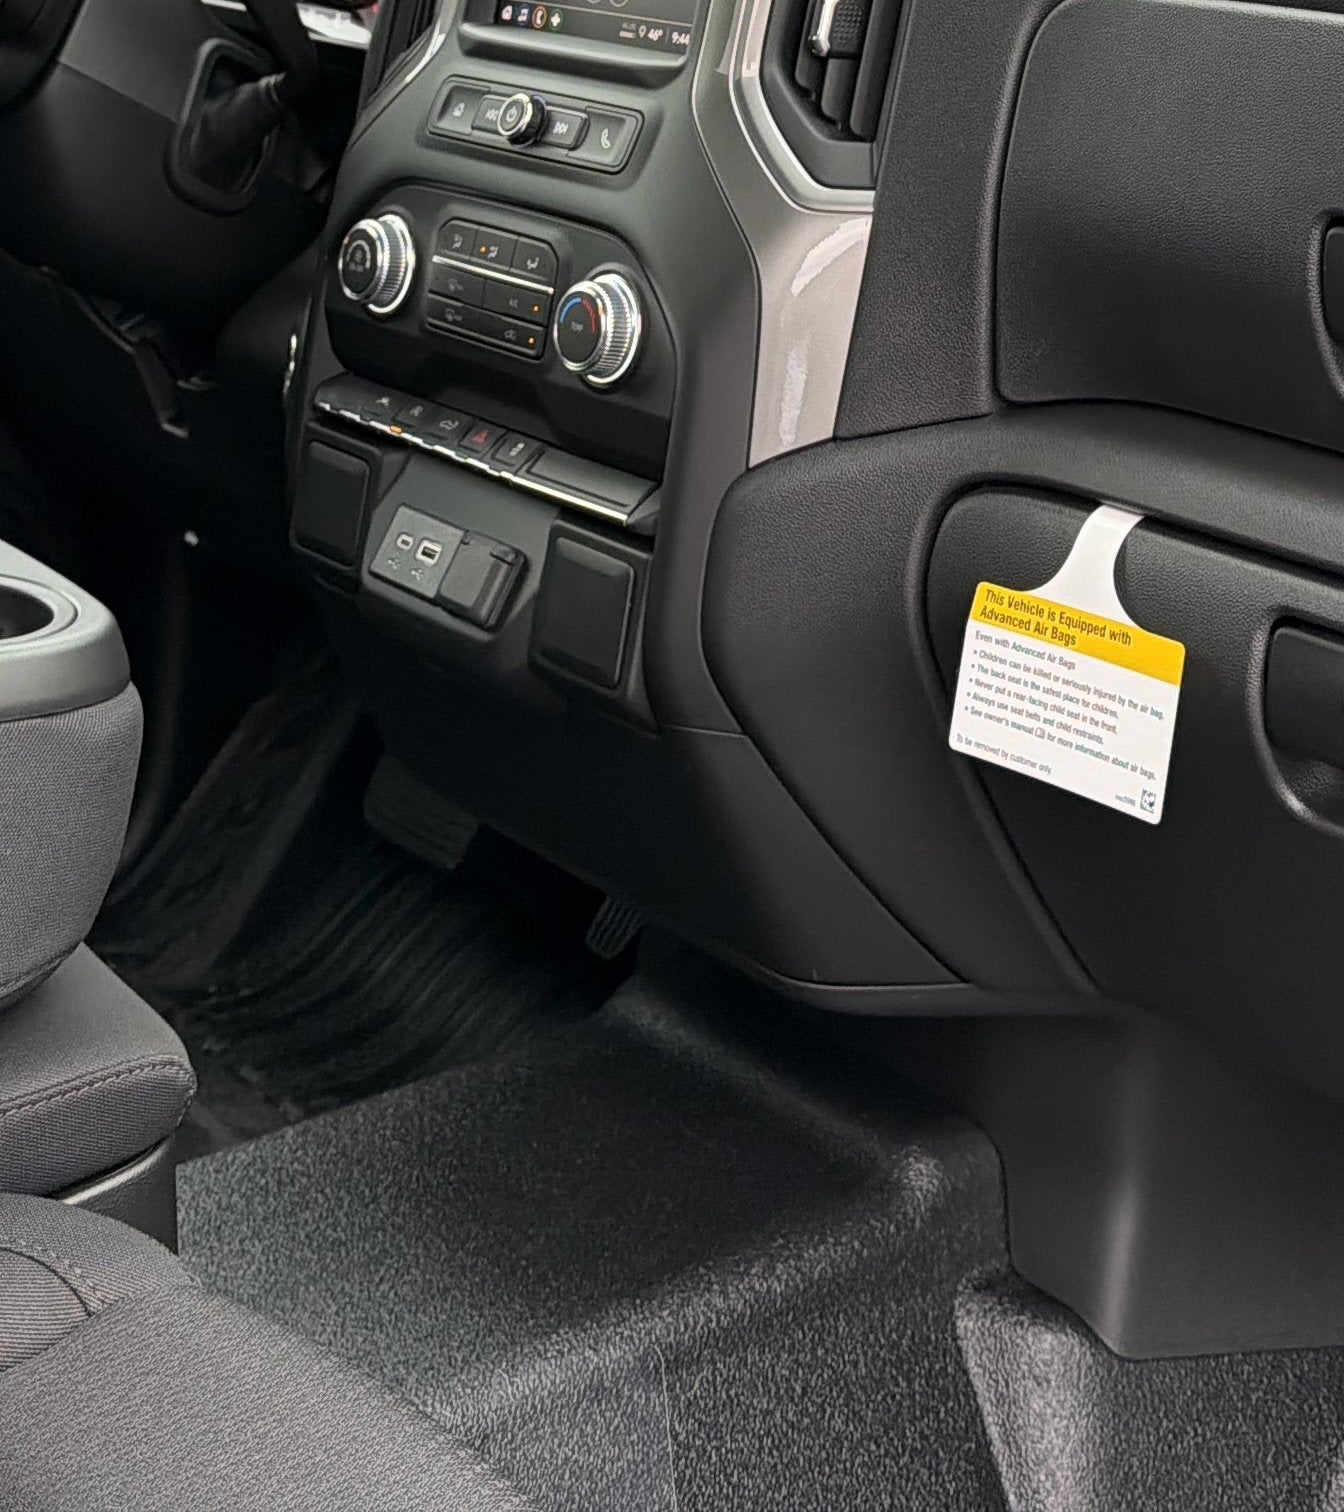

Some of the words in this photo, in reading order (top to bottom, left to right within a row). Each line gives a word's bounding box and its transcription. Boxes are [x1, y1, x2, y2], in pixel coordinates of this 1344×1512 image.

[980, 605, 1031, 631] Advanced
[1033, 621, 1049, 636] Air
[1051, 626, 1076, 647] Bags
[986, 589, 1004, 606] This
[1008, 595, 1044, 618] Vehicle
[1047, 607, 1056, 622] is
[1059, 611, 1106, 637] Equipped
[1109, 629, 1131, 646] with
[975, 630, 993, 643] Even
[995, 638, 1010, 648] with
[1011, 642, 1046, 660] Advanced
[1047, 653, 1057, 663] Air
[1058, 656, 1075, 670] Bags
[975, 678, 994, 691] Never
[994, 686, 1006, 695] put
[1013, 692, 1048, 711] rear-facing
[1050, 704, 1065, 715] child
[1067, 710, 1080, 720] seat
[1089, 717, 1099, 727] the
[978, 663, 989, 675] The
[991, 668, 1006, 680] back
[1008, 675, 1022, 685] seat
[1031, 681, 1040, 691] the
[1042, 686, 1061, 698] safest
[1062, 693, 1080, 705] place
[1082, 698, 1091, 708] for
[979, 650, 1007, 665] Children
[1009, 661, 1021, 670] can
[1023, 663, 1031, 673] be
[1033, 667, 1052, 680] killed
[1062, 678, 1092, 695] seriously
[1093, 686, 1117, 702] injured
[1118, 695, 1126, 707] by
[1128, 699, 1138, 710] the
[1140, 705, 1149, 713] air
[972, 692, 995, 707] Always
[997, 702, 1008, 711] use
[1010, 706, 1024, 716] seat
[1025, 710, 1040, 722] belts
[1043, 717, 1055, 727] and
[1056, 721, 1072, 733] child
[957, 733, 963, 743] To
[965, 737, 972, 746] be
[974, 741, 1000, 756] removed
[1001, 749, 1009, 760] by
[1010, 754, 1037, 768] customer
[970, 706, 982, 717] See
[984, 712, 1009, 726] owner's
[1011, 721, 1034, 735] manual
[1047, 732, 1056, 742] for
[1057, 738, 1073, 749] more
[1075, 743, 1110, 762] information
[1111, 757, 1129, 769] about
